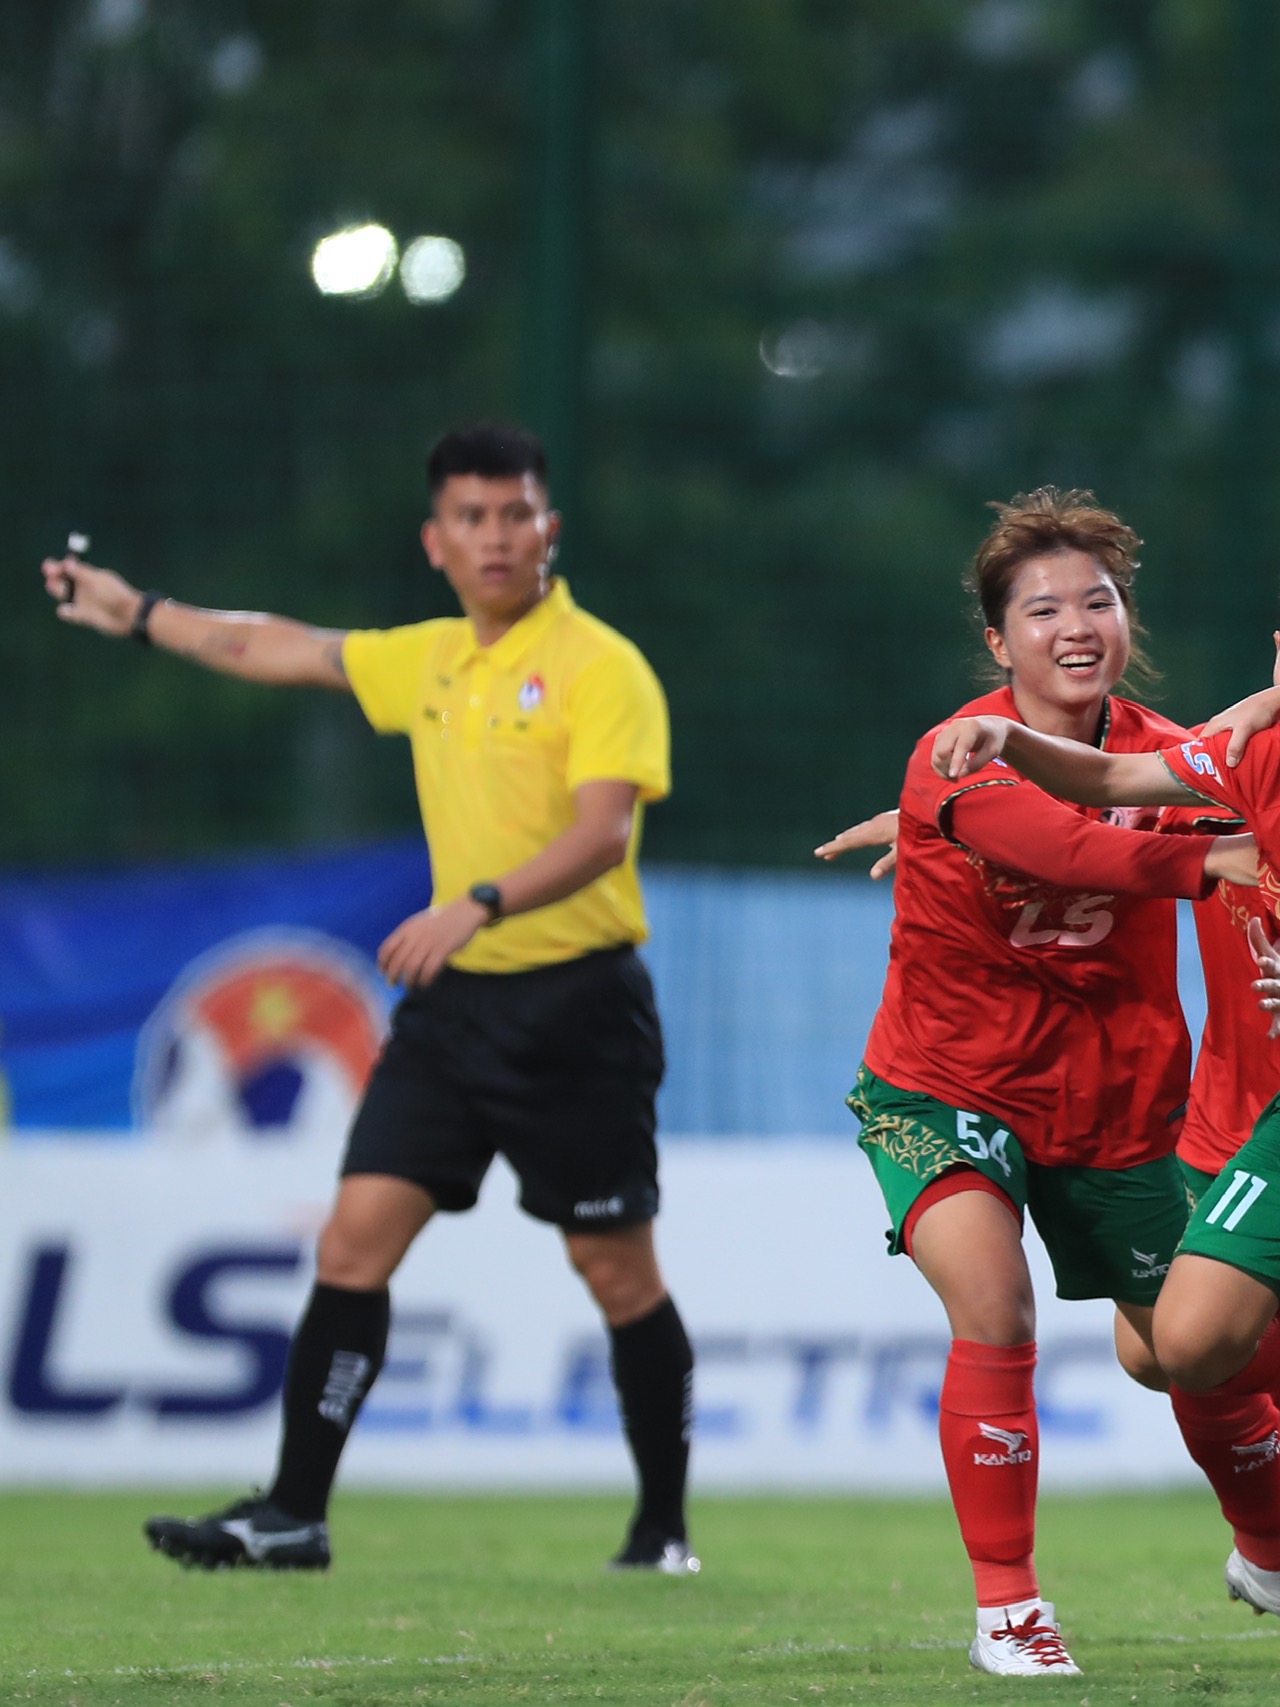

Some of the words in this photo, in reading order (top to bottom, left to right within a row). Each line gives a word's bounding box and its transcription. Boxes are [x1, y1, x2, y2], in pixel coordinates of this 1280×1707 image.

[1010, 894, 1115, 948] LS
[956, 1110, 1012, 1178] 54
[1205, 1169, 1268, 1232] 11
[10, 1243, 302, 1415] LS
